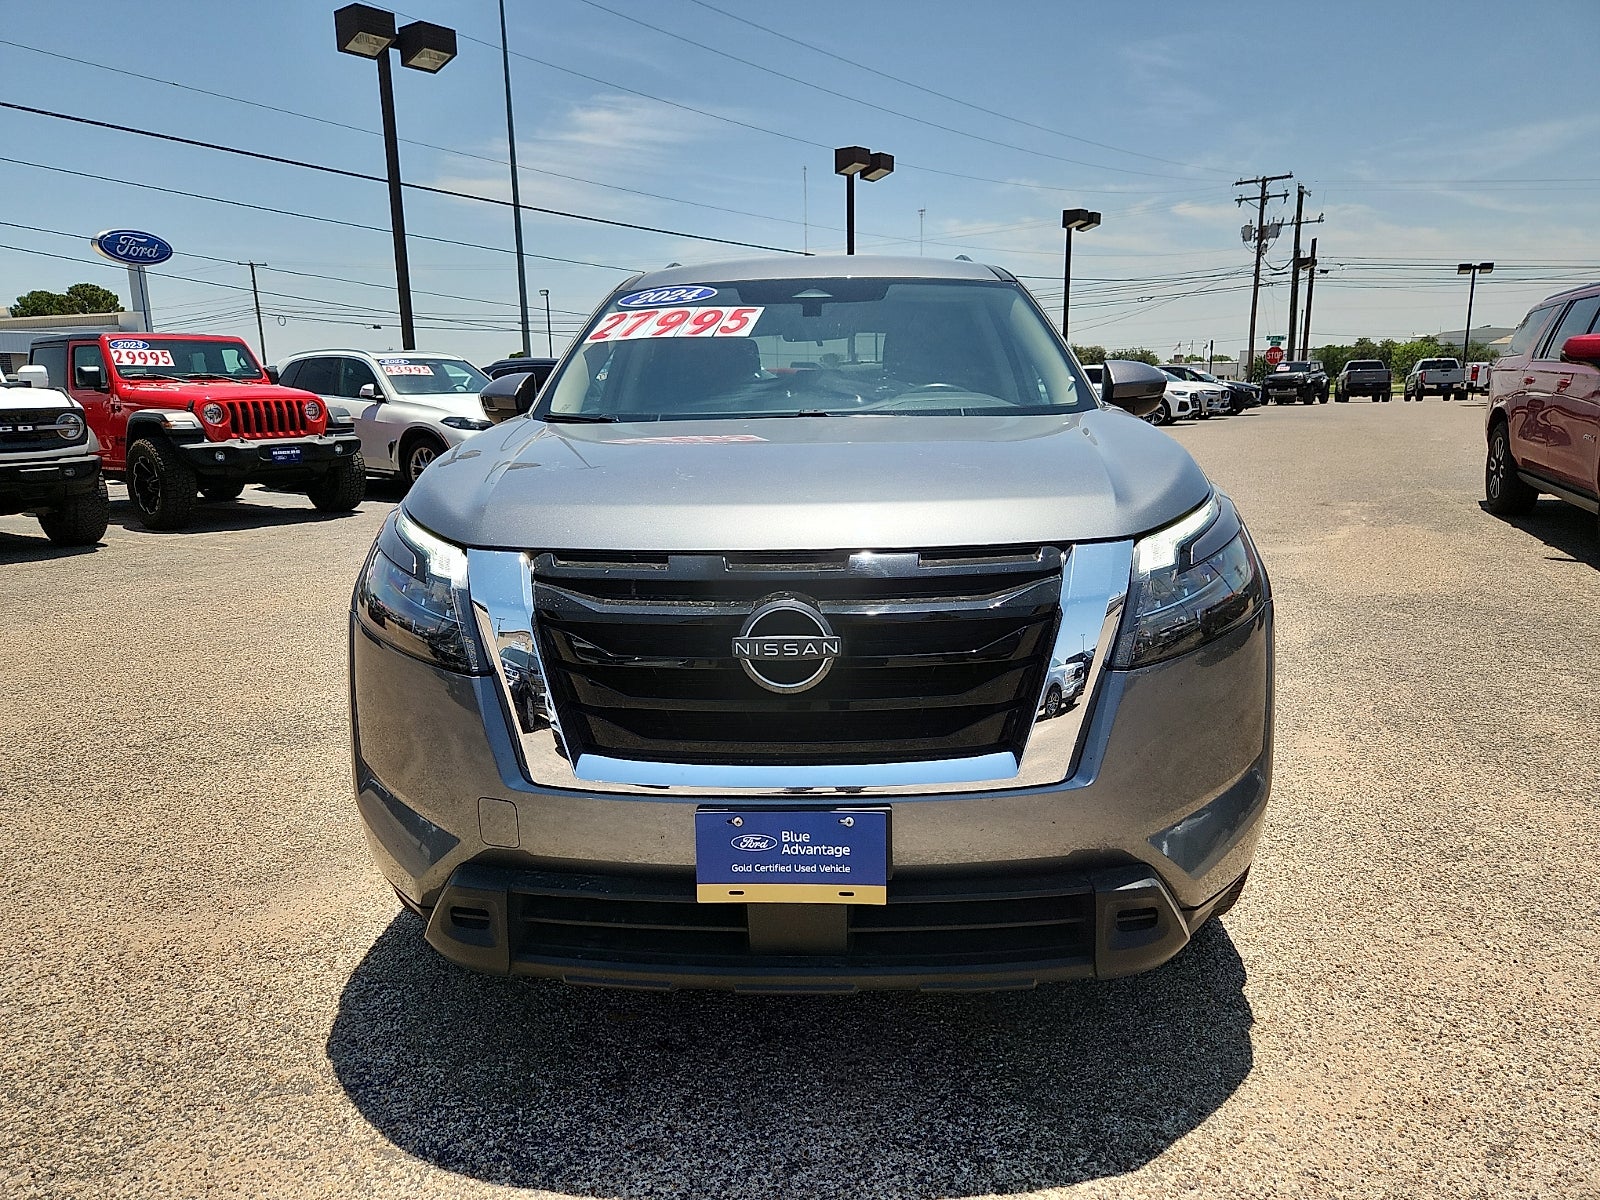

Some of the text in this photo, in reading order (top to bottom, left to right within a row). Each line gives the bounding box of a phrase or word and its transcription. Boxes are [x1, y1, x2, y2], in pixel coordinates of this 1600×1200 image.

[116, 235, 160, 258] Ford
[629, 287, 700, 305] 2024
[589, 308, 758, 341] 27995
[117, 341, 143, 349] 2023
[113, 349, 170, 366] 29995
[1267, 351, 1282, 359] STOP
[734, 641, 839, 656] NISSAN
[739, 835, 769, 850] Ford
[781, 831, 810, 843] Blue
[781, 843, 851, 858] Advantage
[731, 863, 851, 873] Gold Certified Used Vehicle
